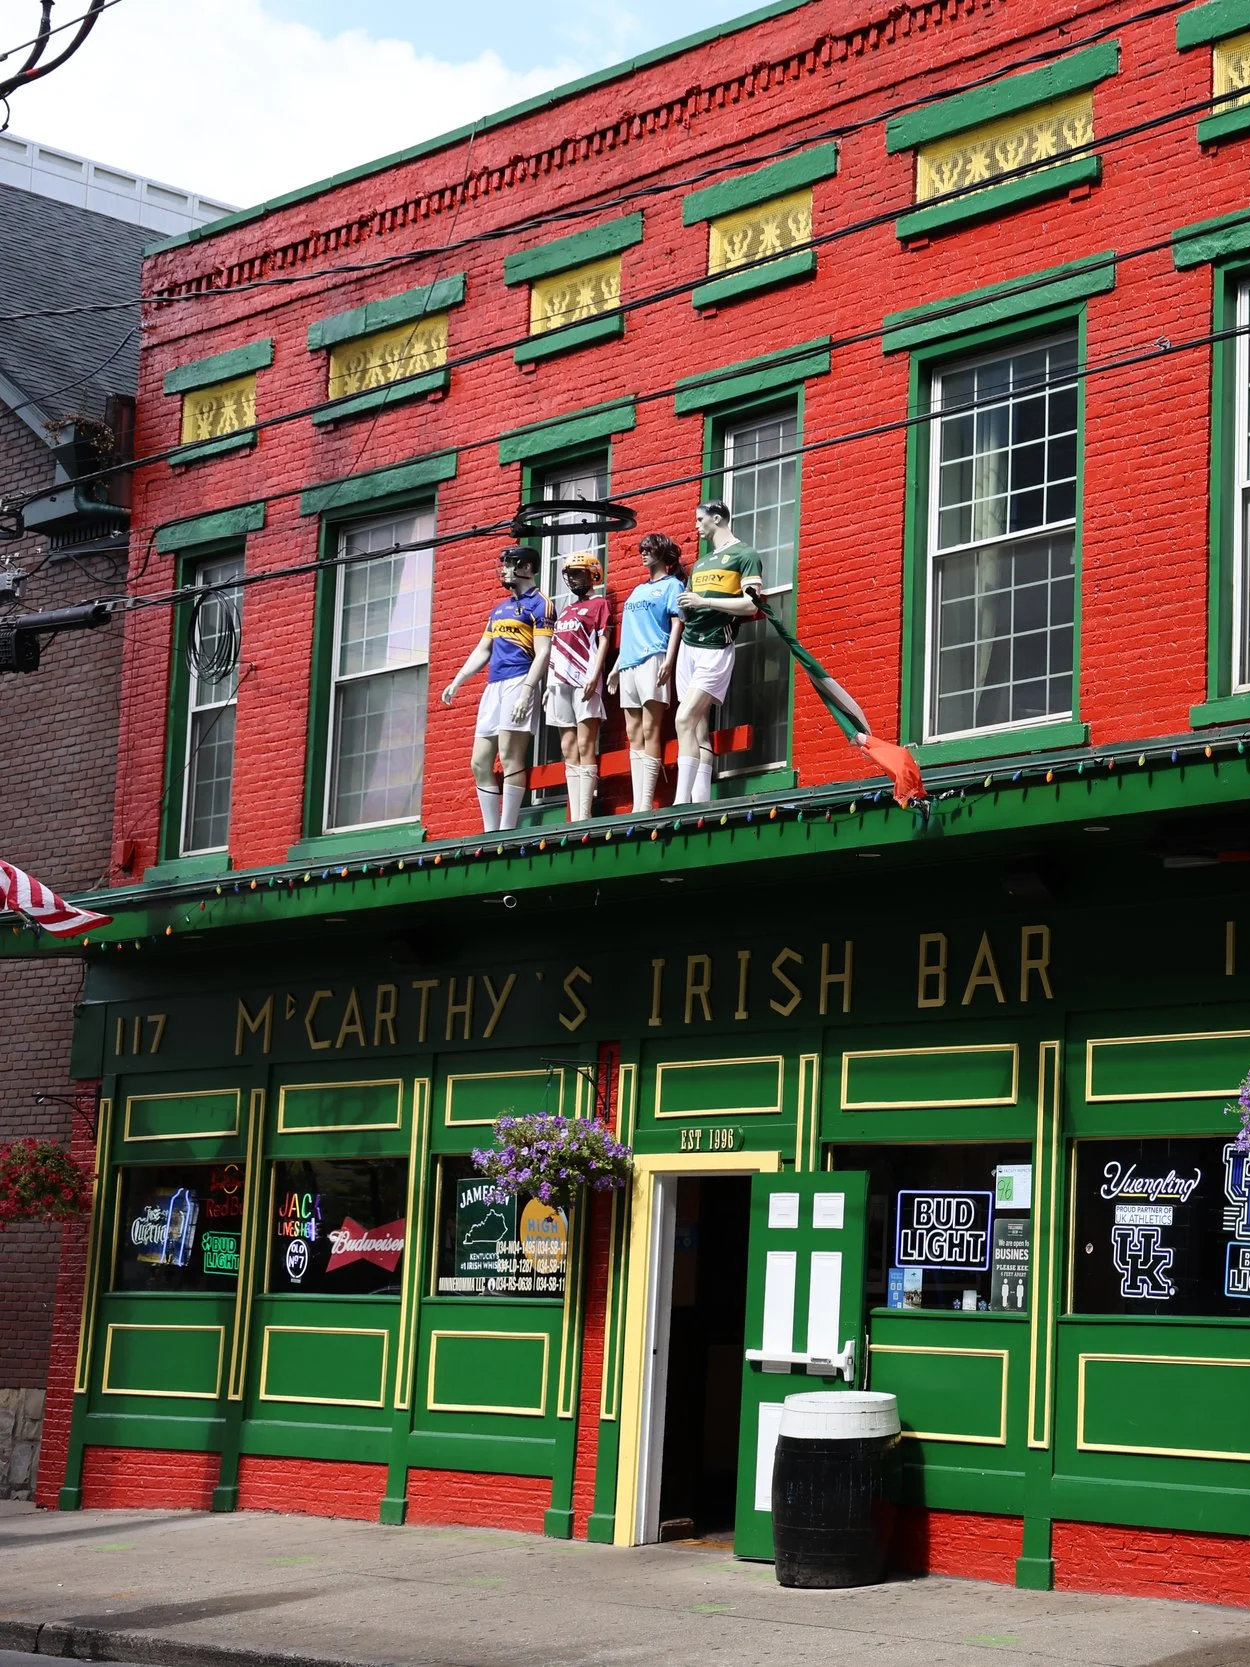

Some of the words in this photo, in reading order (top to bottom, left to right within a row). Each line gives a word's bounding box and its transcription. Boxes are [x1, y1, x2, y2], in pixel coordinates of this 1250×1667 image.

[693, 574, 725, 583] ERRY
[623, 599, 649, 612] taycity
[115, 1014, 167, 1056] 117
[648, 940, 854, 1027] IRISH
[917, 925, 1054, 1009] BAR
[680, 1129, 702, 1150] EST
[709, 1128, 734, 1150] 1996
[997, 1180, 1012, 1200] 96
[1100, 1161, 1201, 1202] Yuengling
[206, 1197, 229, 1217] Red
[913, 1198, 975, 1229] BUD
[528, 1218, 558, 1233] HIGH
[1115, 1213, 1127, 1223] UK
[1129, 1214, 1172, 1225] ATHLETICS
[211, 1237, 237, 1254] BUD
[290, 1243, 305, 1254] OLD
[326, 1231, 404, 1255] Budweiser
[900, 1229, 985, 1262] LIGHT
[998, 1239, 1005, 1247] We
[1013, 1240, 1024, 1249] open
[206, 1252, 240, 1270] LIGHT
[460, 1261, 466, 1270] #1
[467, 1260, 482, 1270] IRISH
[469, 1252, 500, 1261] KENTUCKY'S
[476, 1277, 485, 1291] LLC
